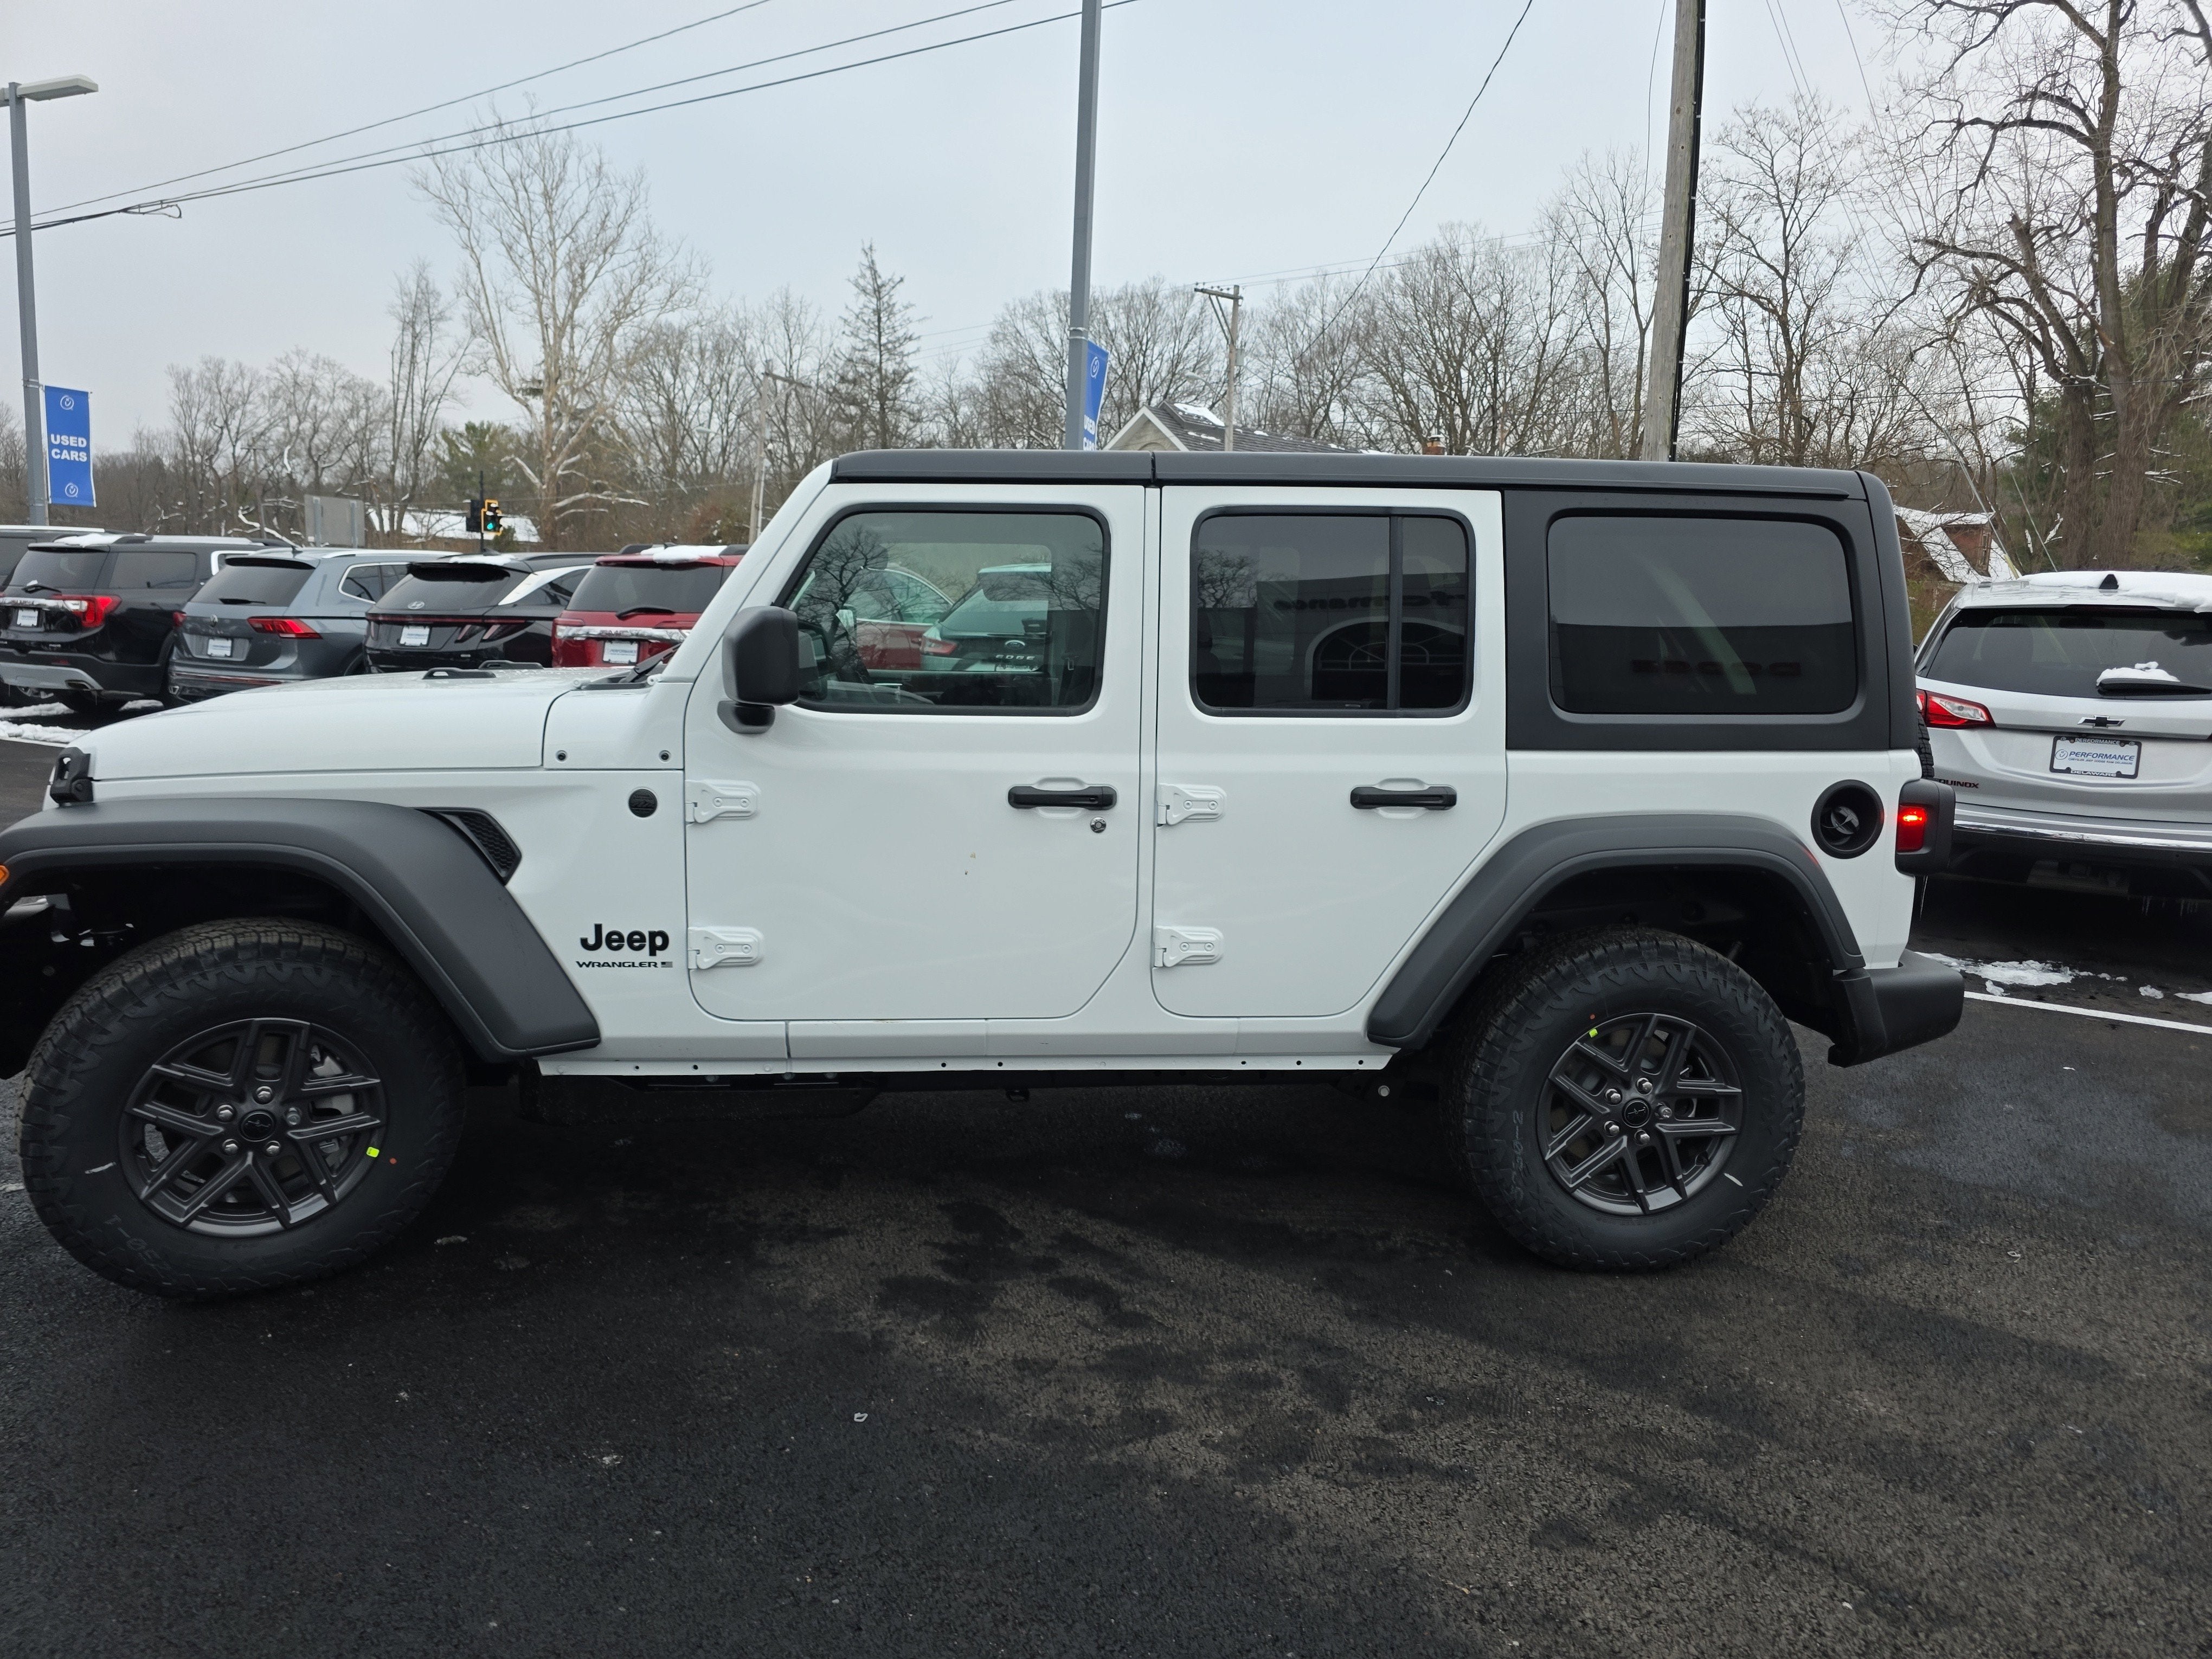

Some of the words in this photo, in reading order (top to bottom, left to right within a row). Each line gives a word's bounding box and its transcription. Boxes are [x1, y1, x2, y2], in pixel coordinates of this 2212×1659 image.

[50, 434, 87, 448] USED
[51, 448, 87, 462] CARS
[2069, 751, 2134, 761] PERFORMANCE
[1939, 779, 1979, 788] QUINOX
[580, 923, 669, 956] Jeep
